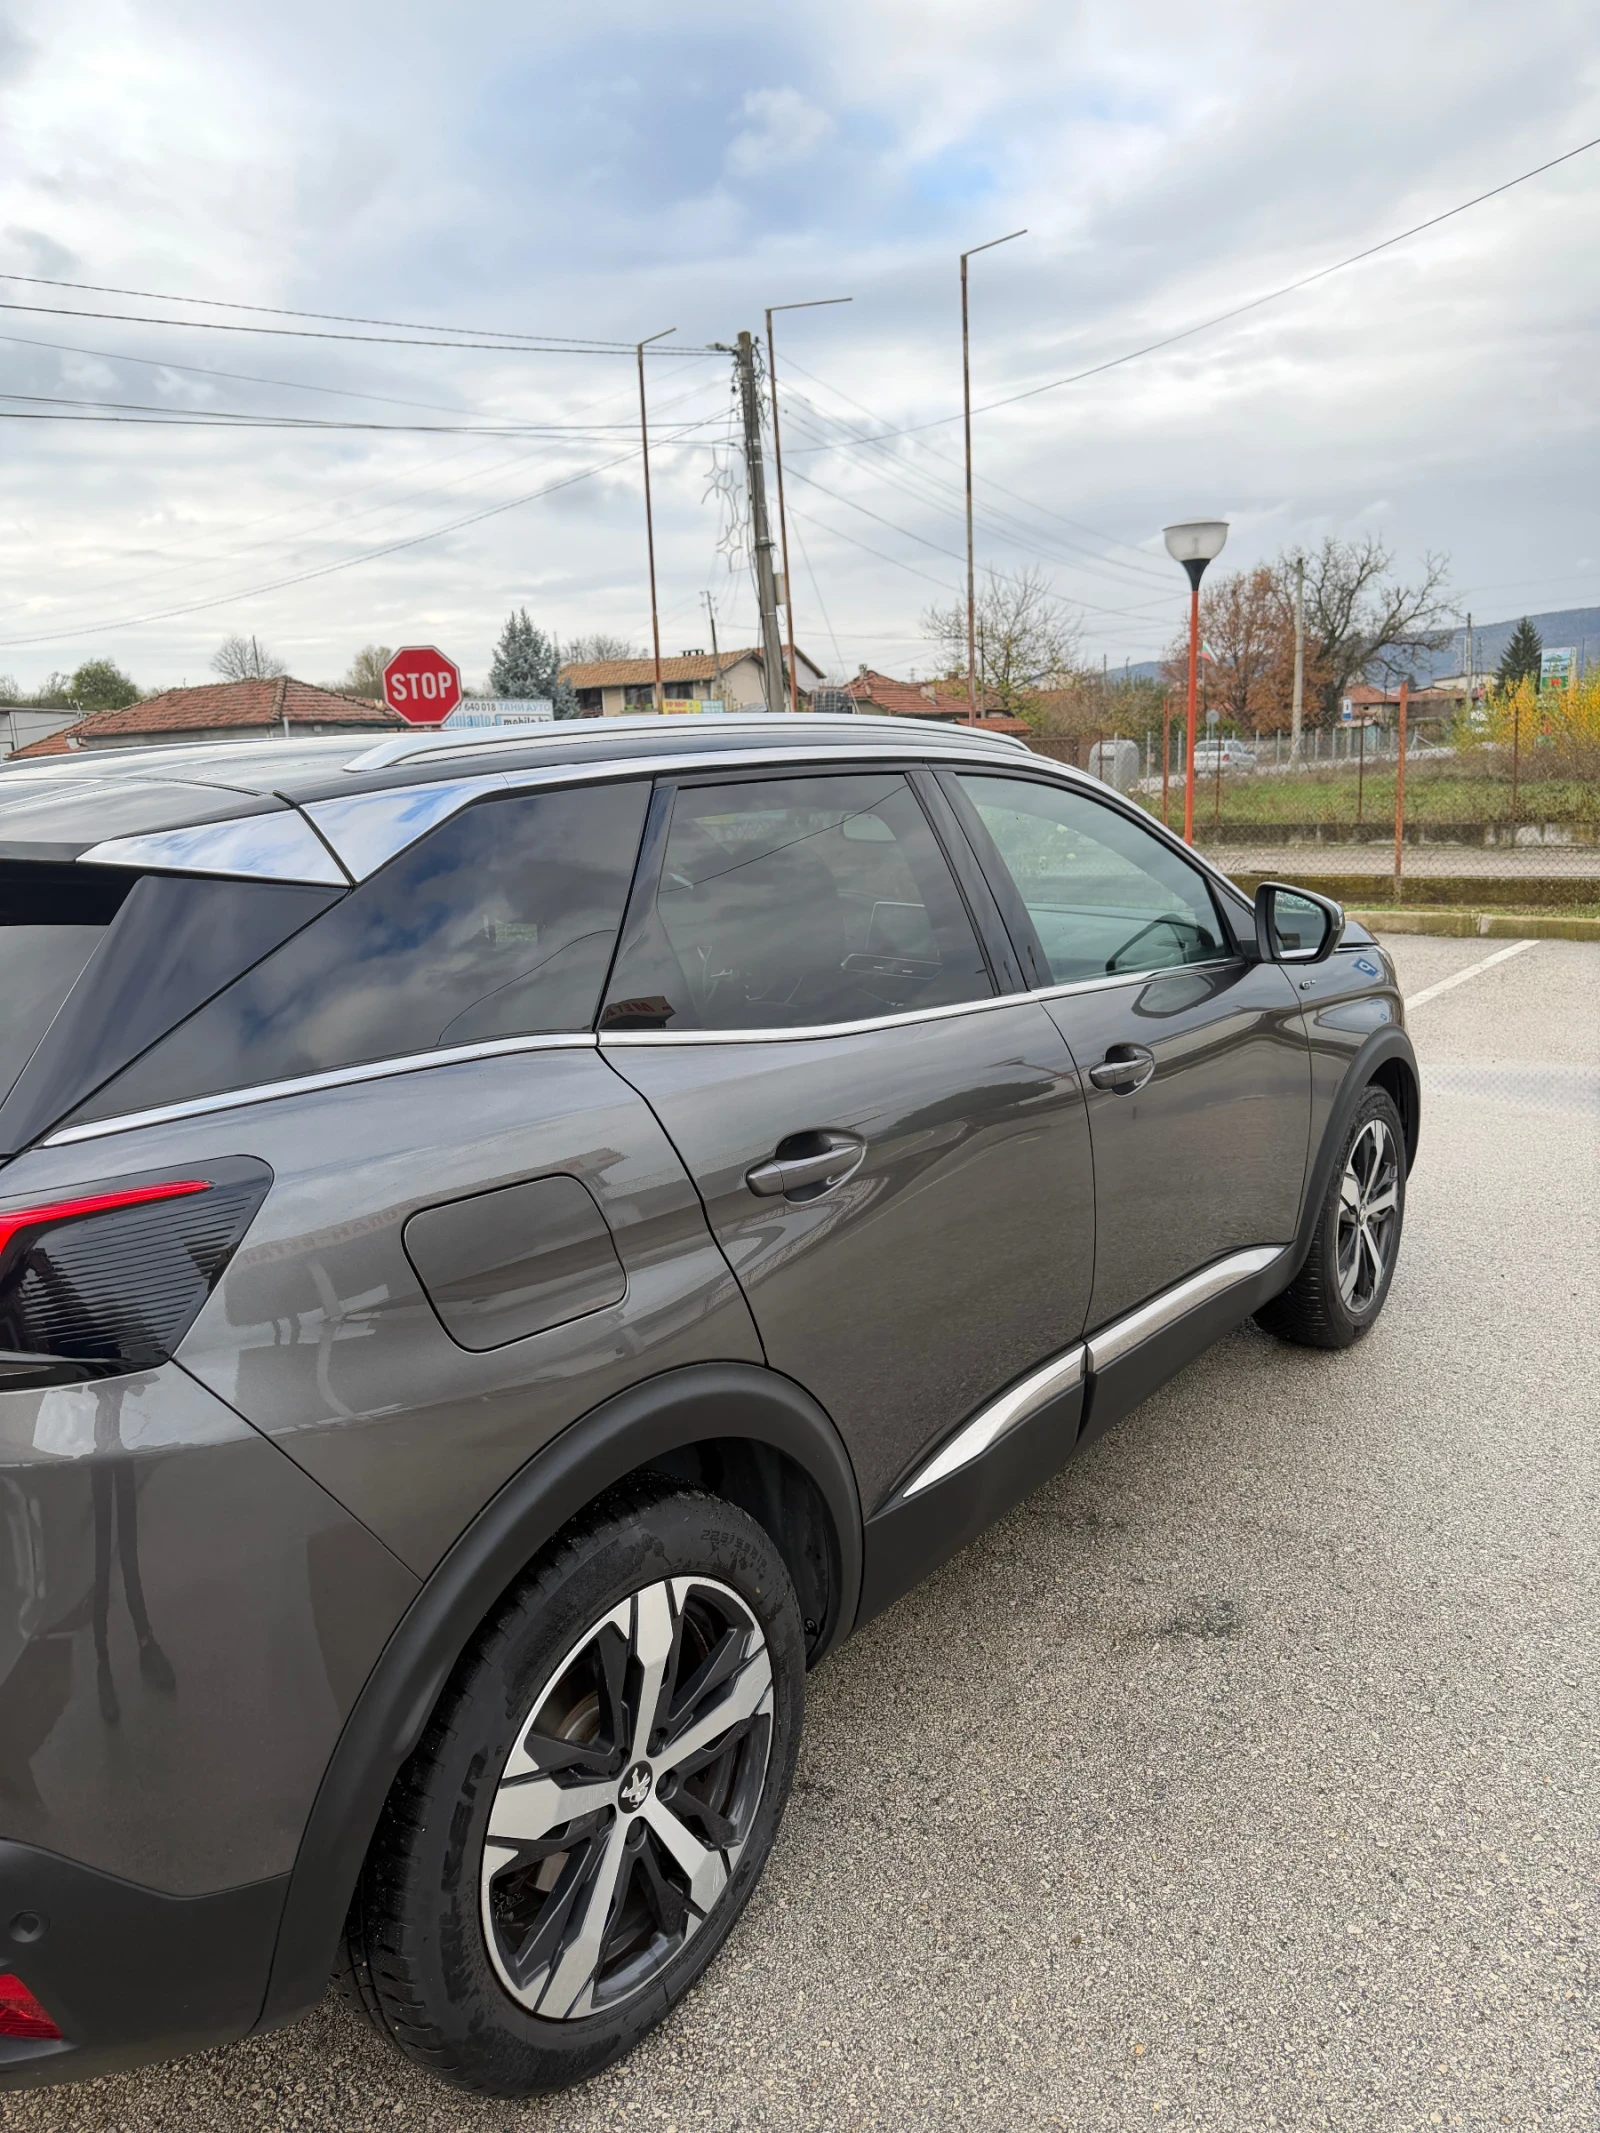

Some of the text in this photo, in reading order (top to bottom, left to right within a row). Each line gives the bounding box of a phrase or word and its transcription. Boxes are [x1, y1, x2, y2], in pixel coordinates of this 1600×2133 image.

[391, 671, 452, 700] STOP
[464, 702, 480, 712] 640
[481, 702, 496, 712] 018
[499, 703, 524, 712] ТАНИ
[526, 703, 551, 712] АУТО
[445, 712, 495, 727] aniauto.
